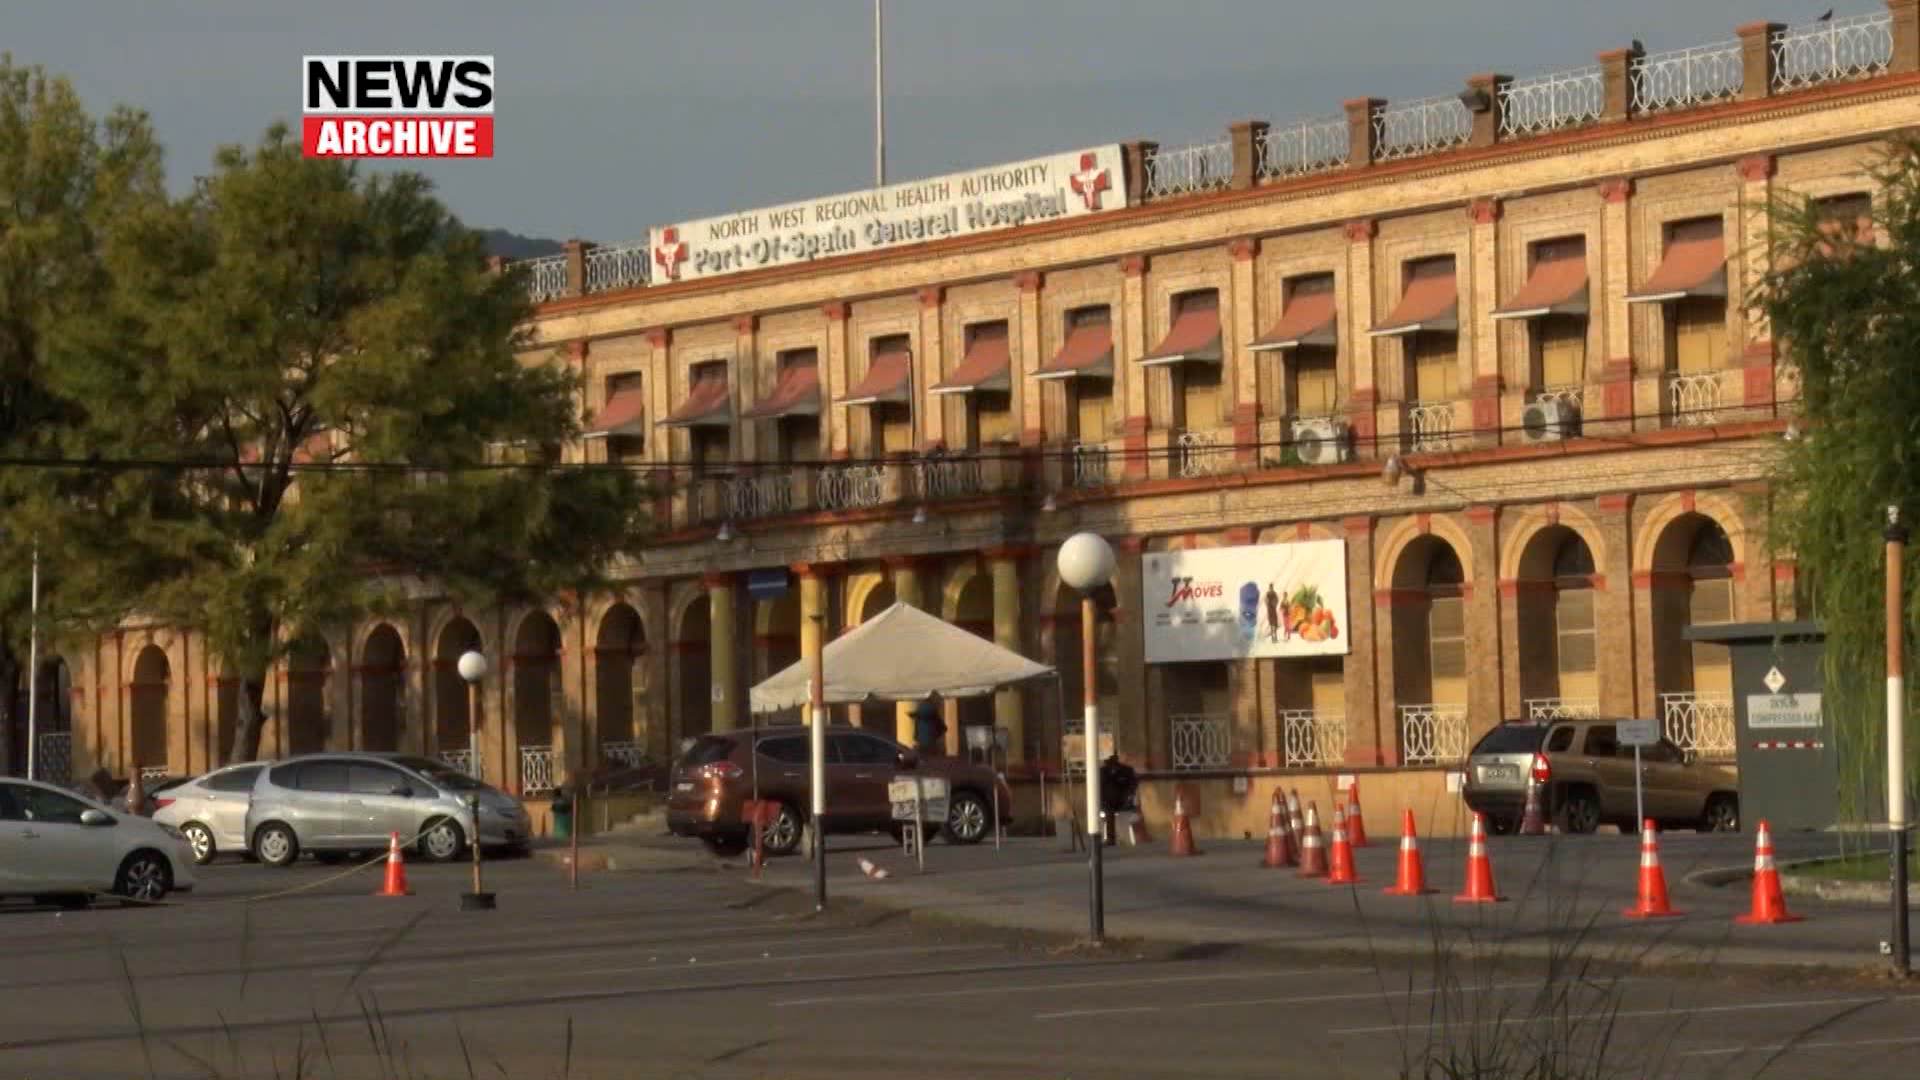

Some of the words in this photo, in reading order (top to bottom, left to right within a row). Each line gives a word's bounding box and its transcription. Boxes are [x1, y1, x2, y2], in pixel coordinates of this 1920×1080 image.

[709, 215, 759, 240] NORTH
[769, 207, 806, 230] WEST
[815, 193, 888, 222] REGIONAL
[896, 181, 950, 208] HEALTH
[960, 163, 1049, 197] AUTHORITY
[863, 205, 959, 246] General
[965, 187, 1069, 231] Hospital
